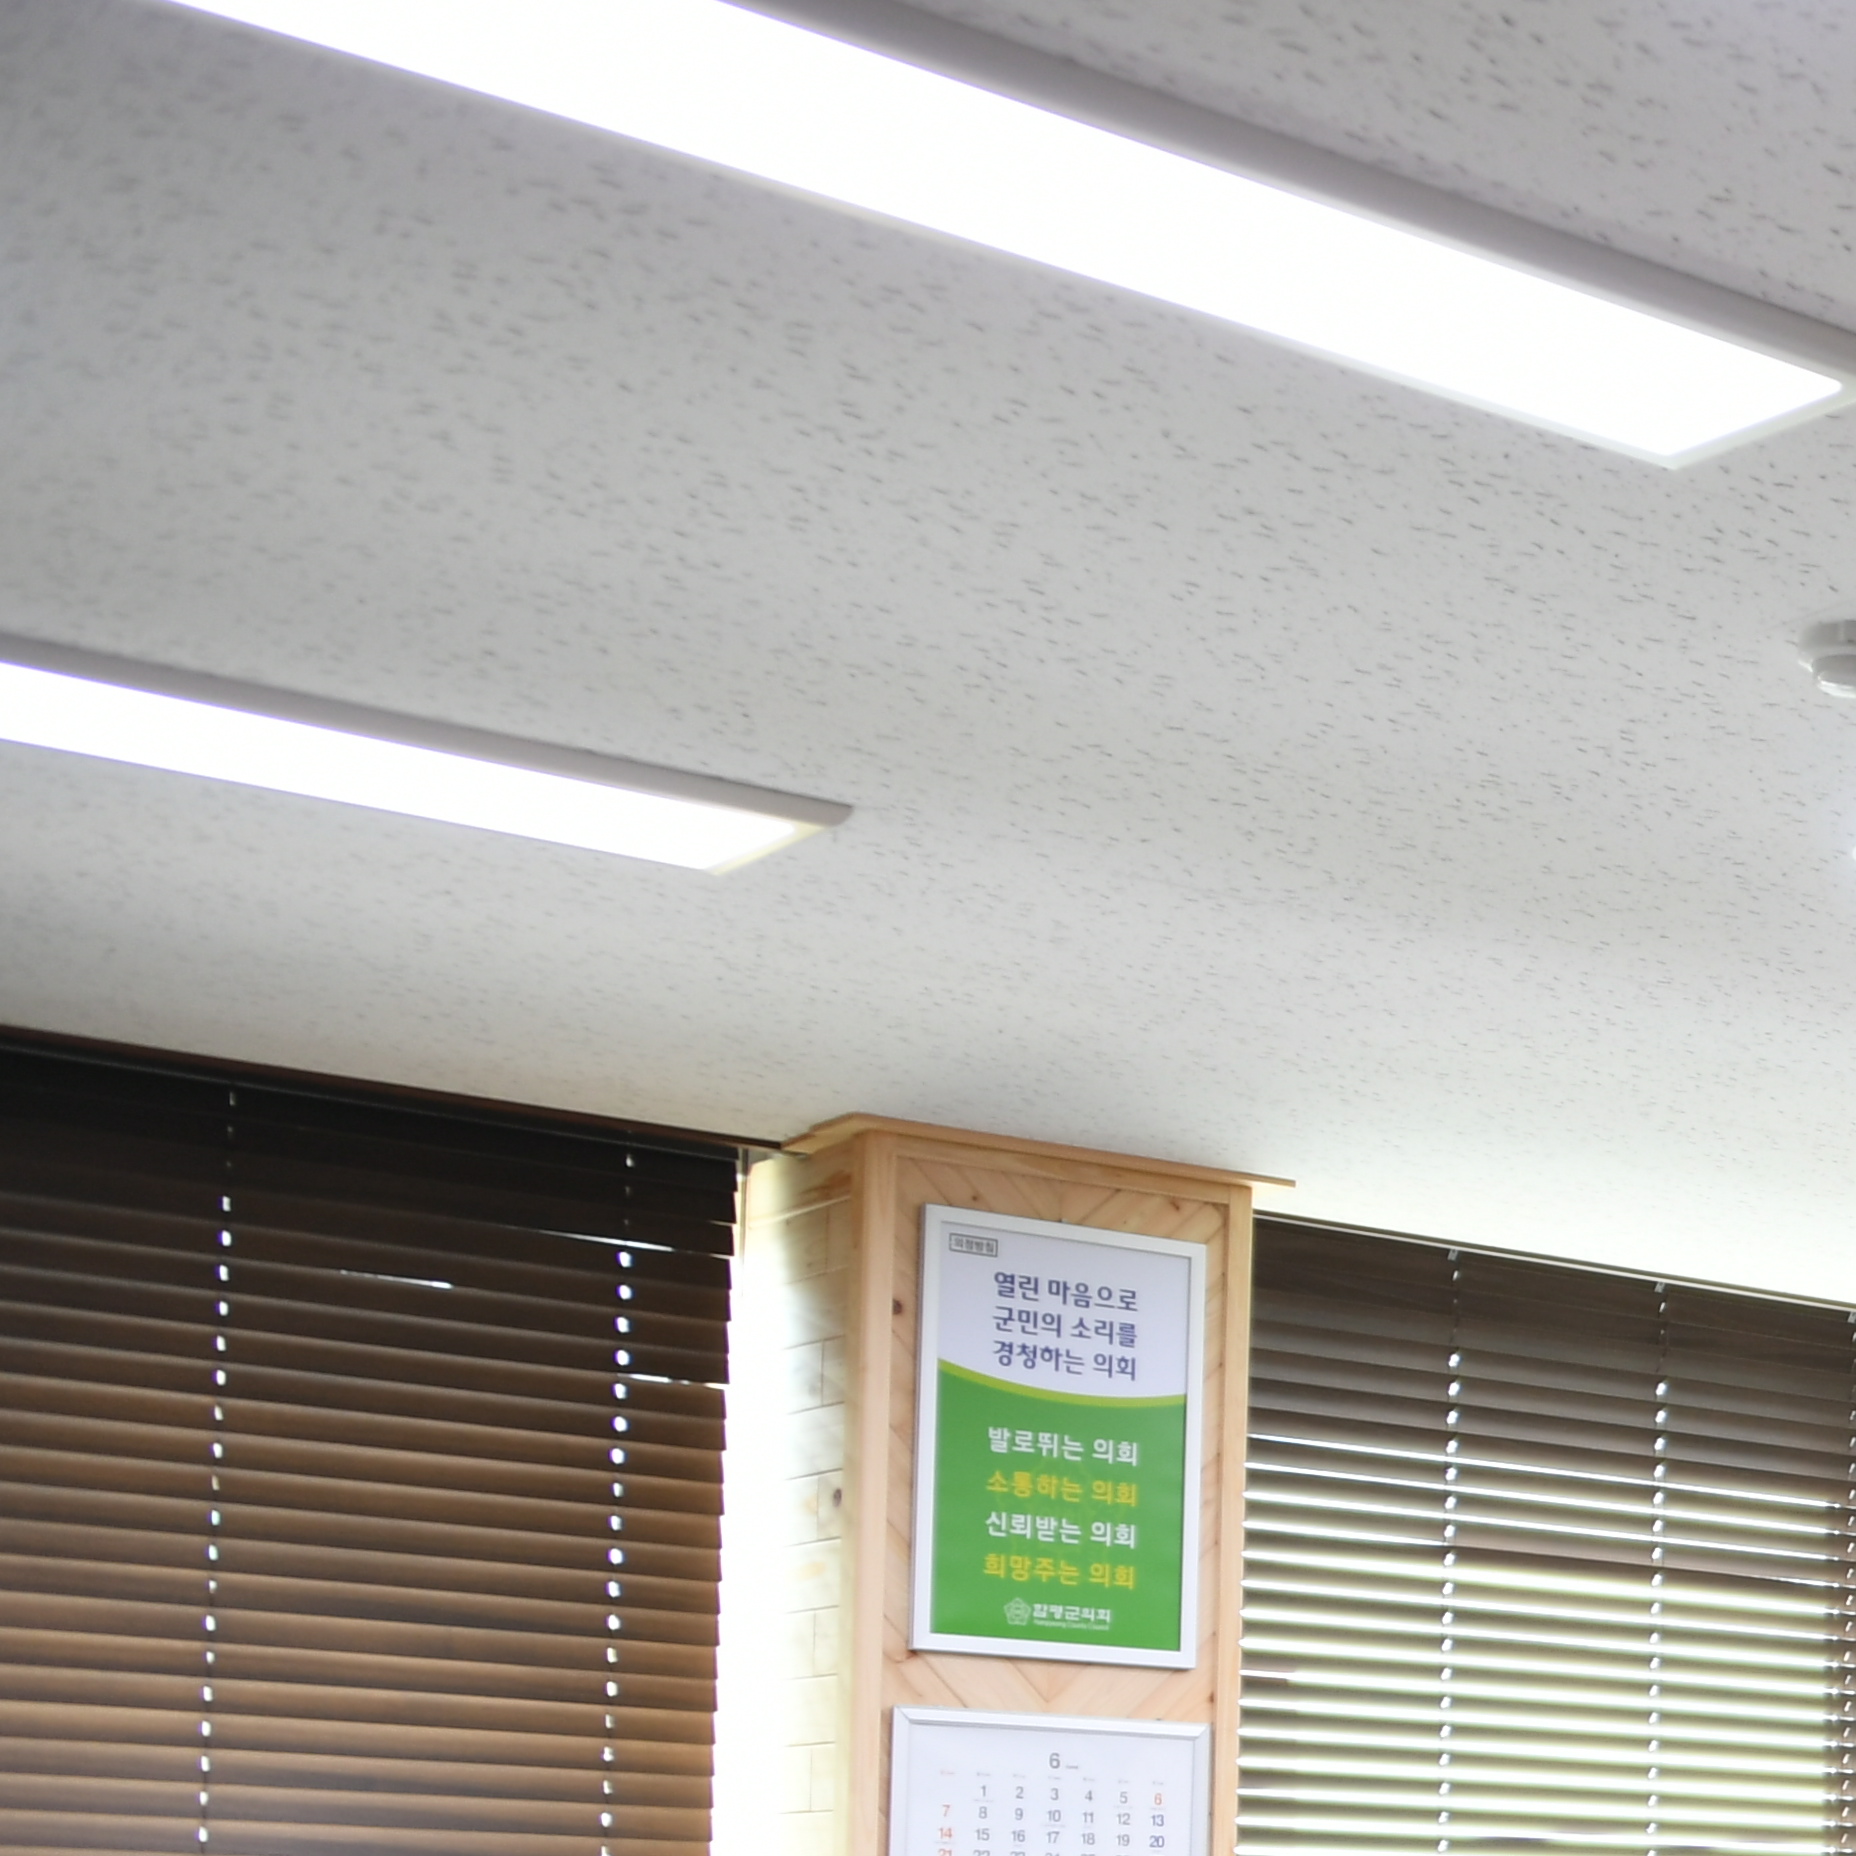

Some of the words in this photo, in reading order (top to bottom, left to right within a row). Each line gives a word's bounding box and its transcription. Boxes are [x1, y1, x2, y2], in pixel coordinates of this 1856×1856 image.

[993, 1271, 1039, 1302] 열린
[1047, 1278, 1138, 1312] 마음으로
[992, 1305, 1062, 1339] 군민의
[1069, 1317, 1138, 1348] 소리를
[992, 1340, 1085, 1375] 경청하는
[1092, 1353, 1136, 1381] 의회
[987, 1426, 1084, 1462] 발로뛰는
[1092, 1438, 1138, 1467] 의회
[985, 1470, 1083, 1503] 소통하는
[1091, 1479, 1137, 1507] 의회
[985, 1511, 1082, 1544] 신뢰받는
[1089, 1521, 1136, 1549] 의회
[983, 1553, 1080, 1586] 희망주는
[1088, 1562, 1134, 1589] 의회
[1049, 1752, 1061, 1770] 6
[1015, 1785, 1025, 1800] 2
[1050, 1787, 1060, 1801] 3
[1084, 1789, 1094, 1802] 4
[1119, 1791, 1129, 1805] 5
[1153, 1792, 1163, 1806] 6
[941, 1804, 951, 1818] 7
[978, 1805, 988, 1820] 8
[1014, 1807, 1024, 1821] 9
[1047, 1809, 1062, 1823] 10
[1082, 1811, 1095, 1824] 11
[1116, 1812, 1131, 1826] 12
[1151, 1813, 1165, 1828] 13
[938, 1827, 953, 1840] 14
[975, 1827, 991, 1842] 15
[1011, 1829, 1026, 1843] 16
[1046, 1830, 1061, 1844] 17
[1081, 1832, 1096, 1846] 18
[1116, 1833, 1131, 1847] 19
[1148, 1834, 1165, 1849] 20
